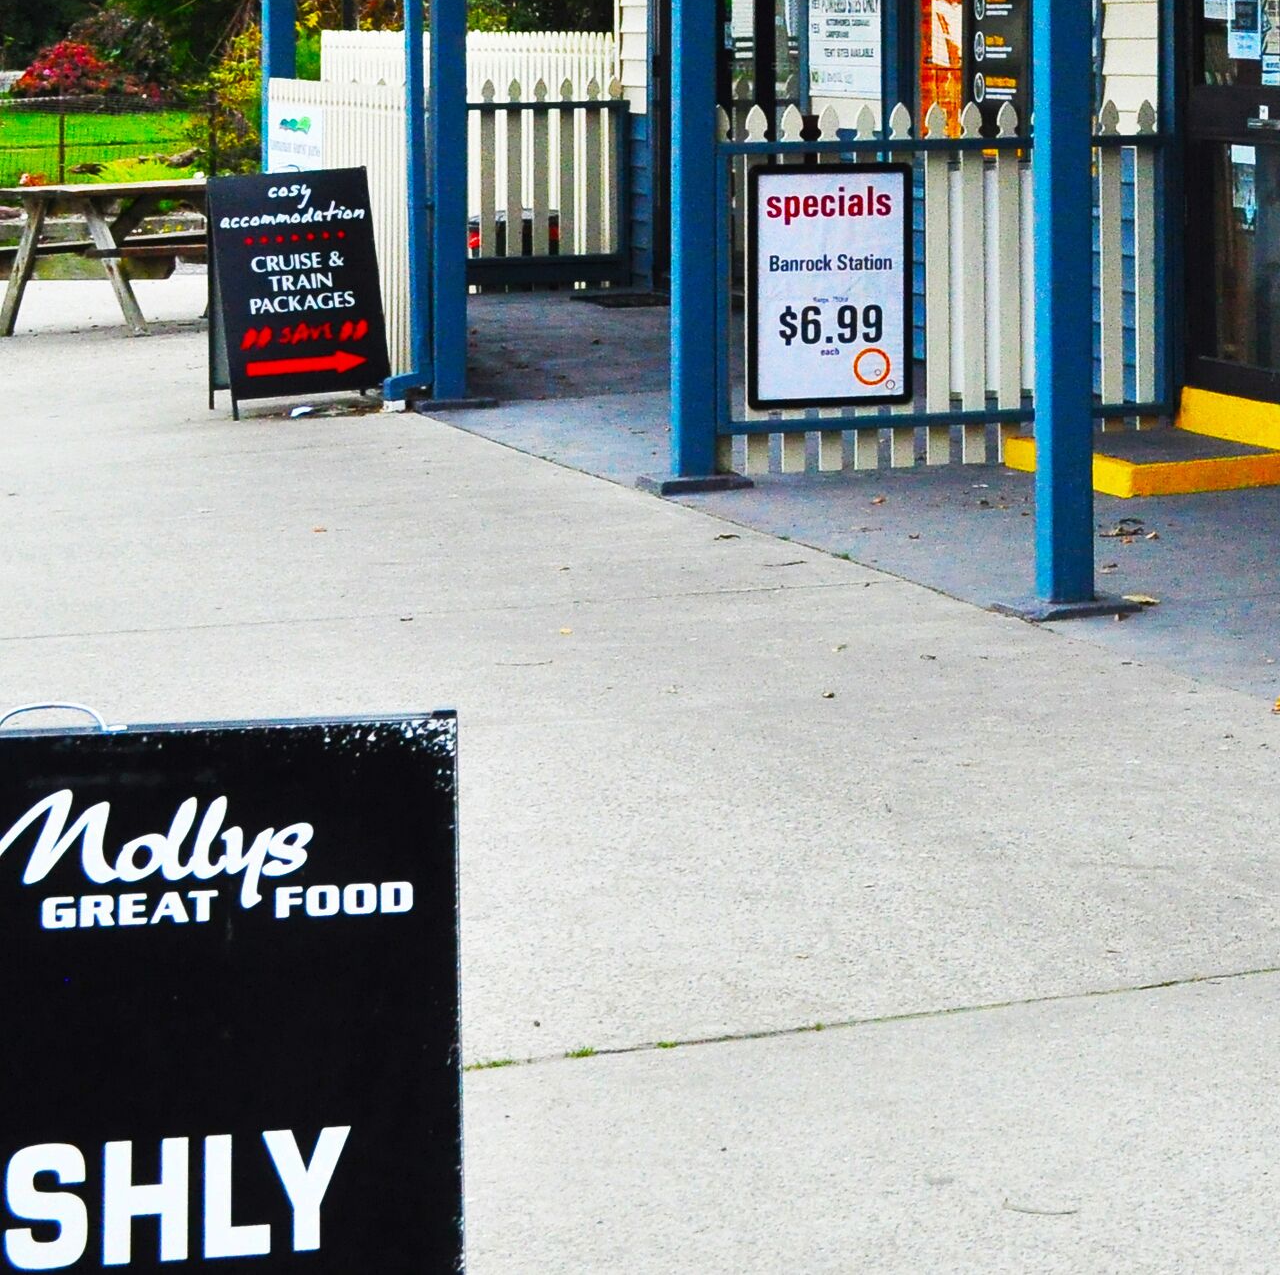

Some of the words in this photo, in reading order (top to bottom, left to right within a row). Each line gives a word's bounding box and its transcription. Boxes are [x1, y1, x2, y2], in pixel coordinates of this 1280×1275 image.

[267, 184, 312, 209] cosy
[766, 185, 892, 226] specials
[219, 200, 366, 229] accommodation
[250, 251, 322, 273] CRUISE
[328, 251, 345, 267] &
[769, 254, 833, 272] Banrock
[837, 253, 893, 271] Station
[268, 272, 333, 292] TRAIN
[249, 290, 356, 315] PACKAGES
[778, 304, 884, 347] $6.99
[820, 347, 840, 357] each
[0, 788, 315, 909] Mollys
[40, 889, 219, 930] GREAT
[274, 880, 414, 920] FOOD
[4, 1124, 352, 1271] SHLY
